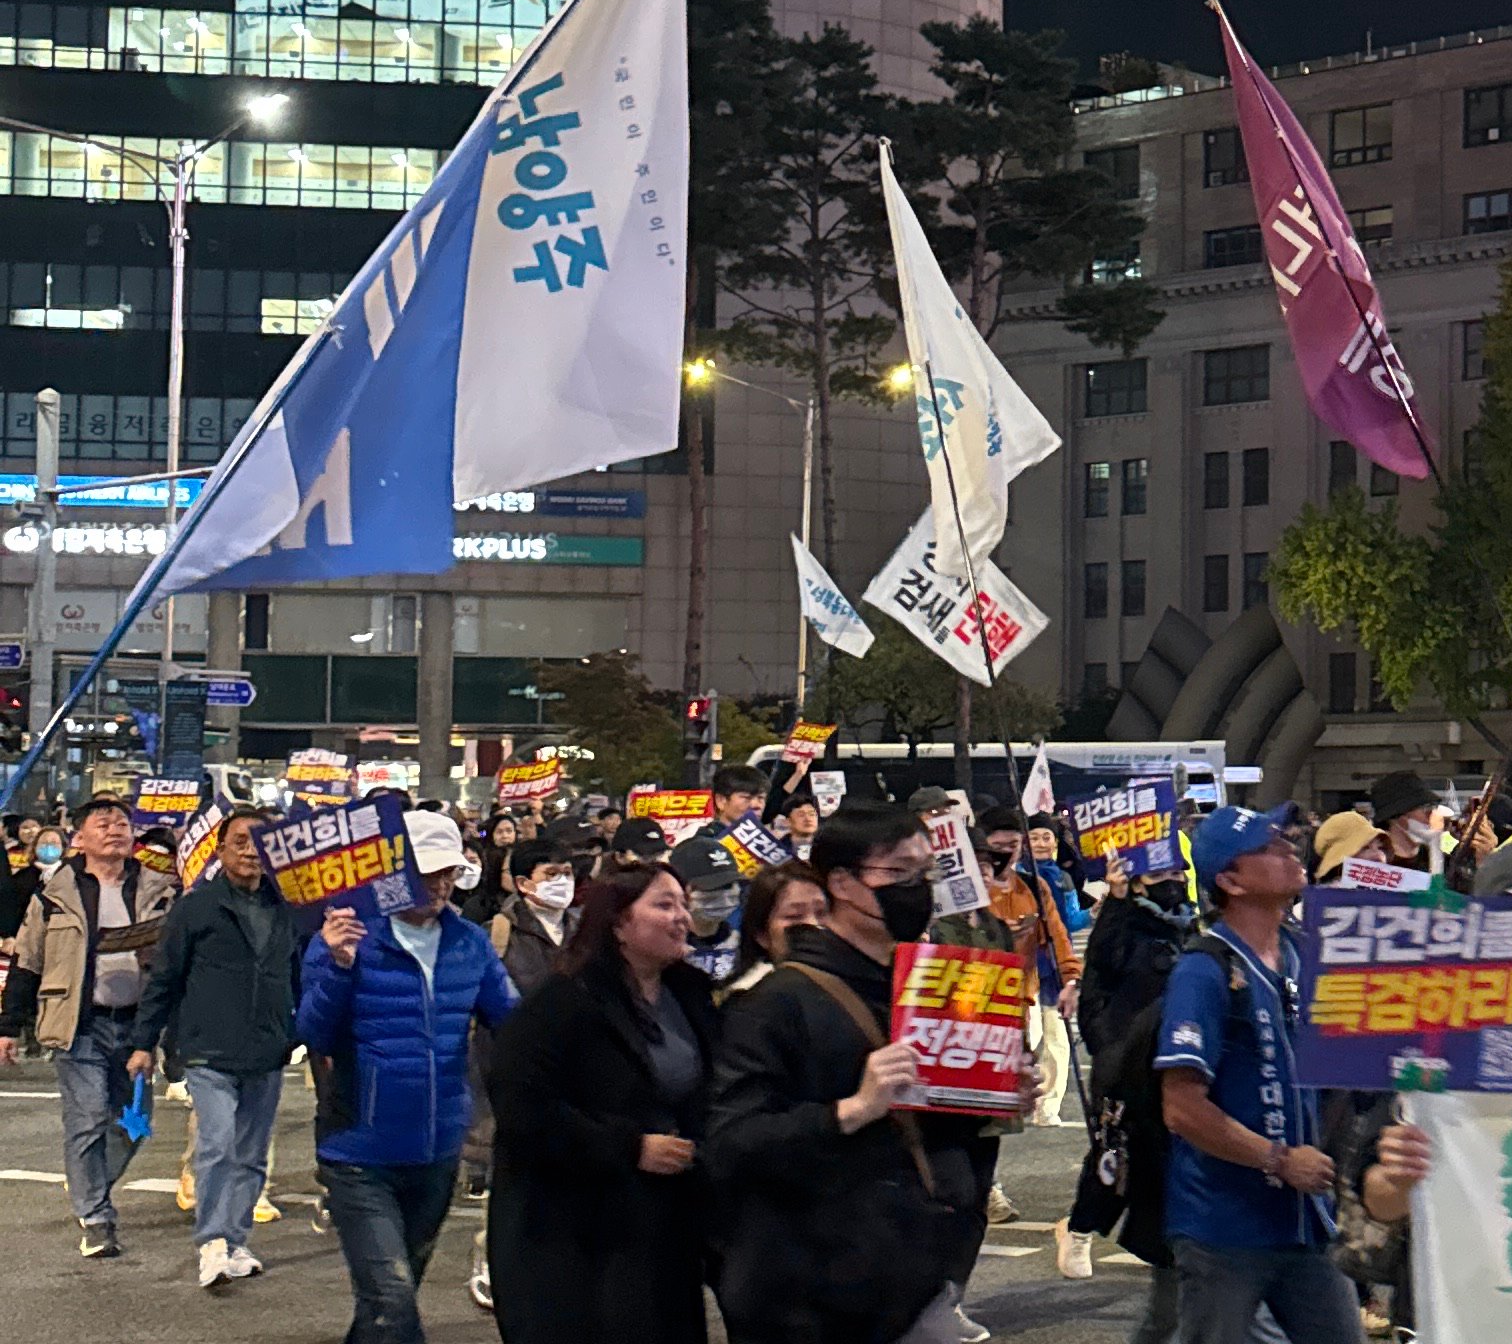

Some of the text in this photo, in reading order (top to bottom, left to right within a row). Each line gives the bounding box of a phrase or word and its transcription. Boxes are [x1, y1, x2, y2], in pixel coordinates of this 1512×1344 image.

[492, 71, 609, 293] 남양주
[261, 804, 381, 870] 김건희를
[1074, 787, 1158, 832] 김건희를
[275, 834, 406, 904] 특검하라!
[897, 958, 1024, 1017] 탄핵으
[906, 1016, 1023, 1075] 전쟁막
